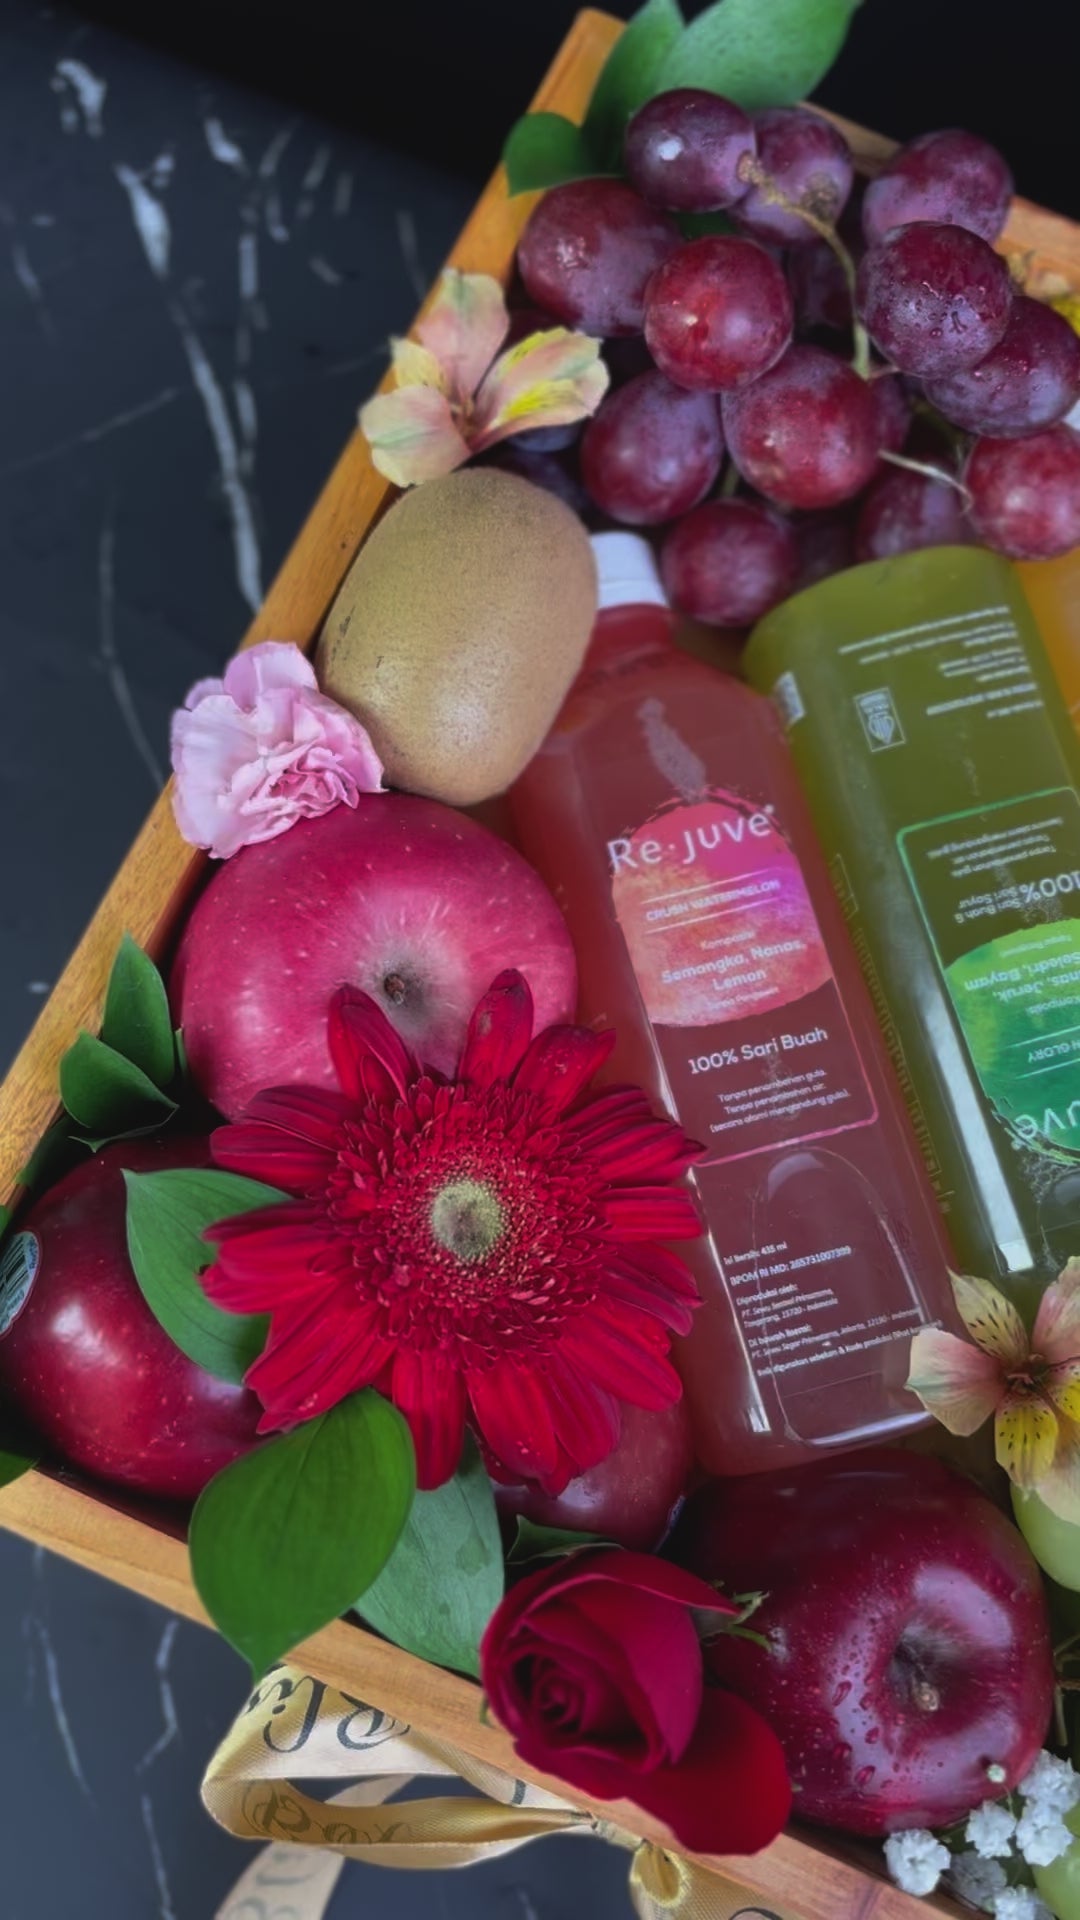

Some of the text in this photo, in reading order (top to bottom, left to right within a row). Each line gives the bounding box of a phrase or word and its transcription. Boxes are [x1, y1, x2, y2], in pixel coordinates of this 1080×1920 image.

[646, 879, 779, 920] CRUSH WATERMELON
[958, 892, 991, 909] Sayur
[713, 967, 766, 991] Lemon
[964, 965, 1019, 991] Bayam
[992, 980, 1043, 1003] Jeruk,
[688, 1026, 827, 1074] 100% Sari Buah
[1027, 1043, 1069, 1061] GLORY
[719, 1089, 746, 1103] Tanpa
[748, 1074, 805, 1096] penambahan
[725, 1101, 752, 1114] Tanpa
[754, 1085, 810, 1106] penambahan
